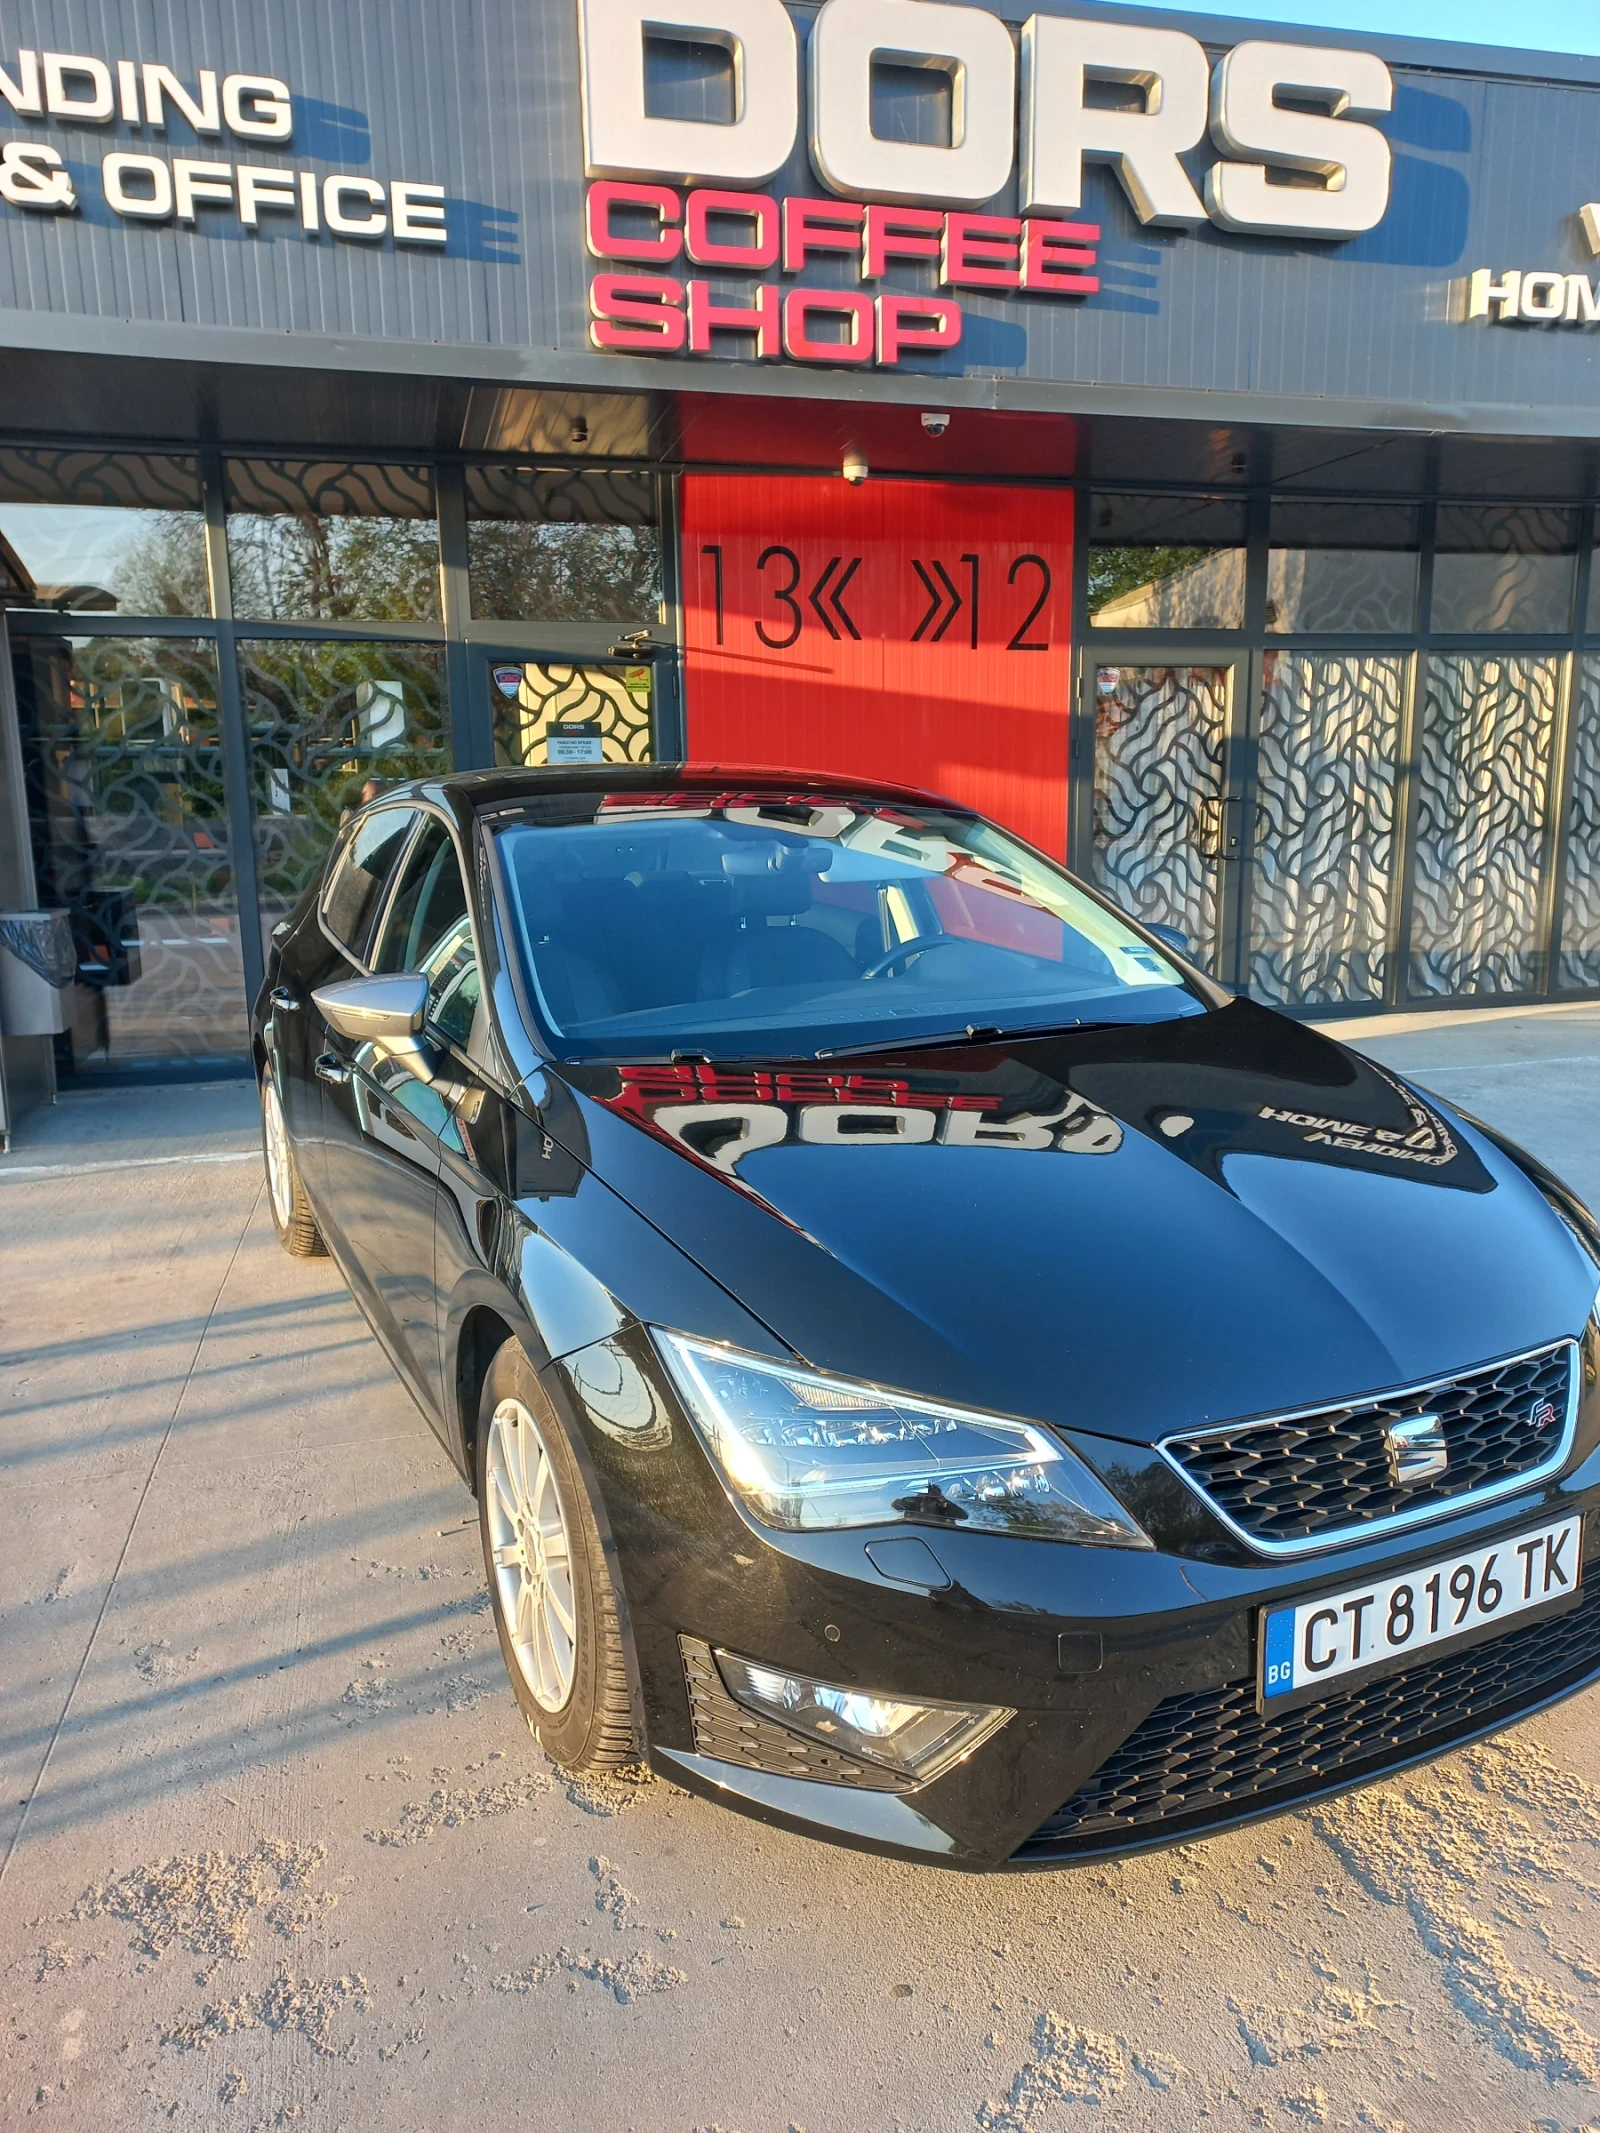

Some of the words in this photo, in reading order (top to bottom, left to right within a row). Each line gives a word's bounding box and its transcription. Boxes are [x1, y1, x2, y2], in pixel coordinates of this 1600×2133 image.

[578, 0, 1393, 240] DORS
[0, 141, 78, 212] &
[102, 152, 448, 245] OFFICE
[586, 181, 1100, 295] COFFEE
[589, 274, 962, 365] SHOP
[1304, 1594, 1375, 1673] CT
[1386, 1553, 1503, 1646] 8196
[1516, 1528, 1572, 1600] TK
[1268, 1661, 1291, 1685] BG
